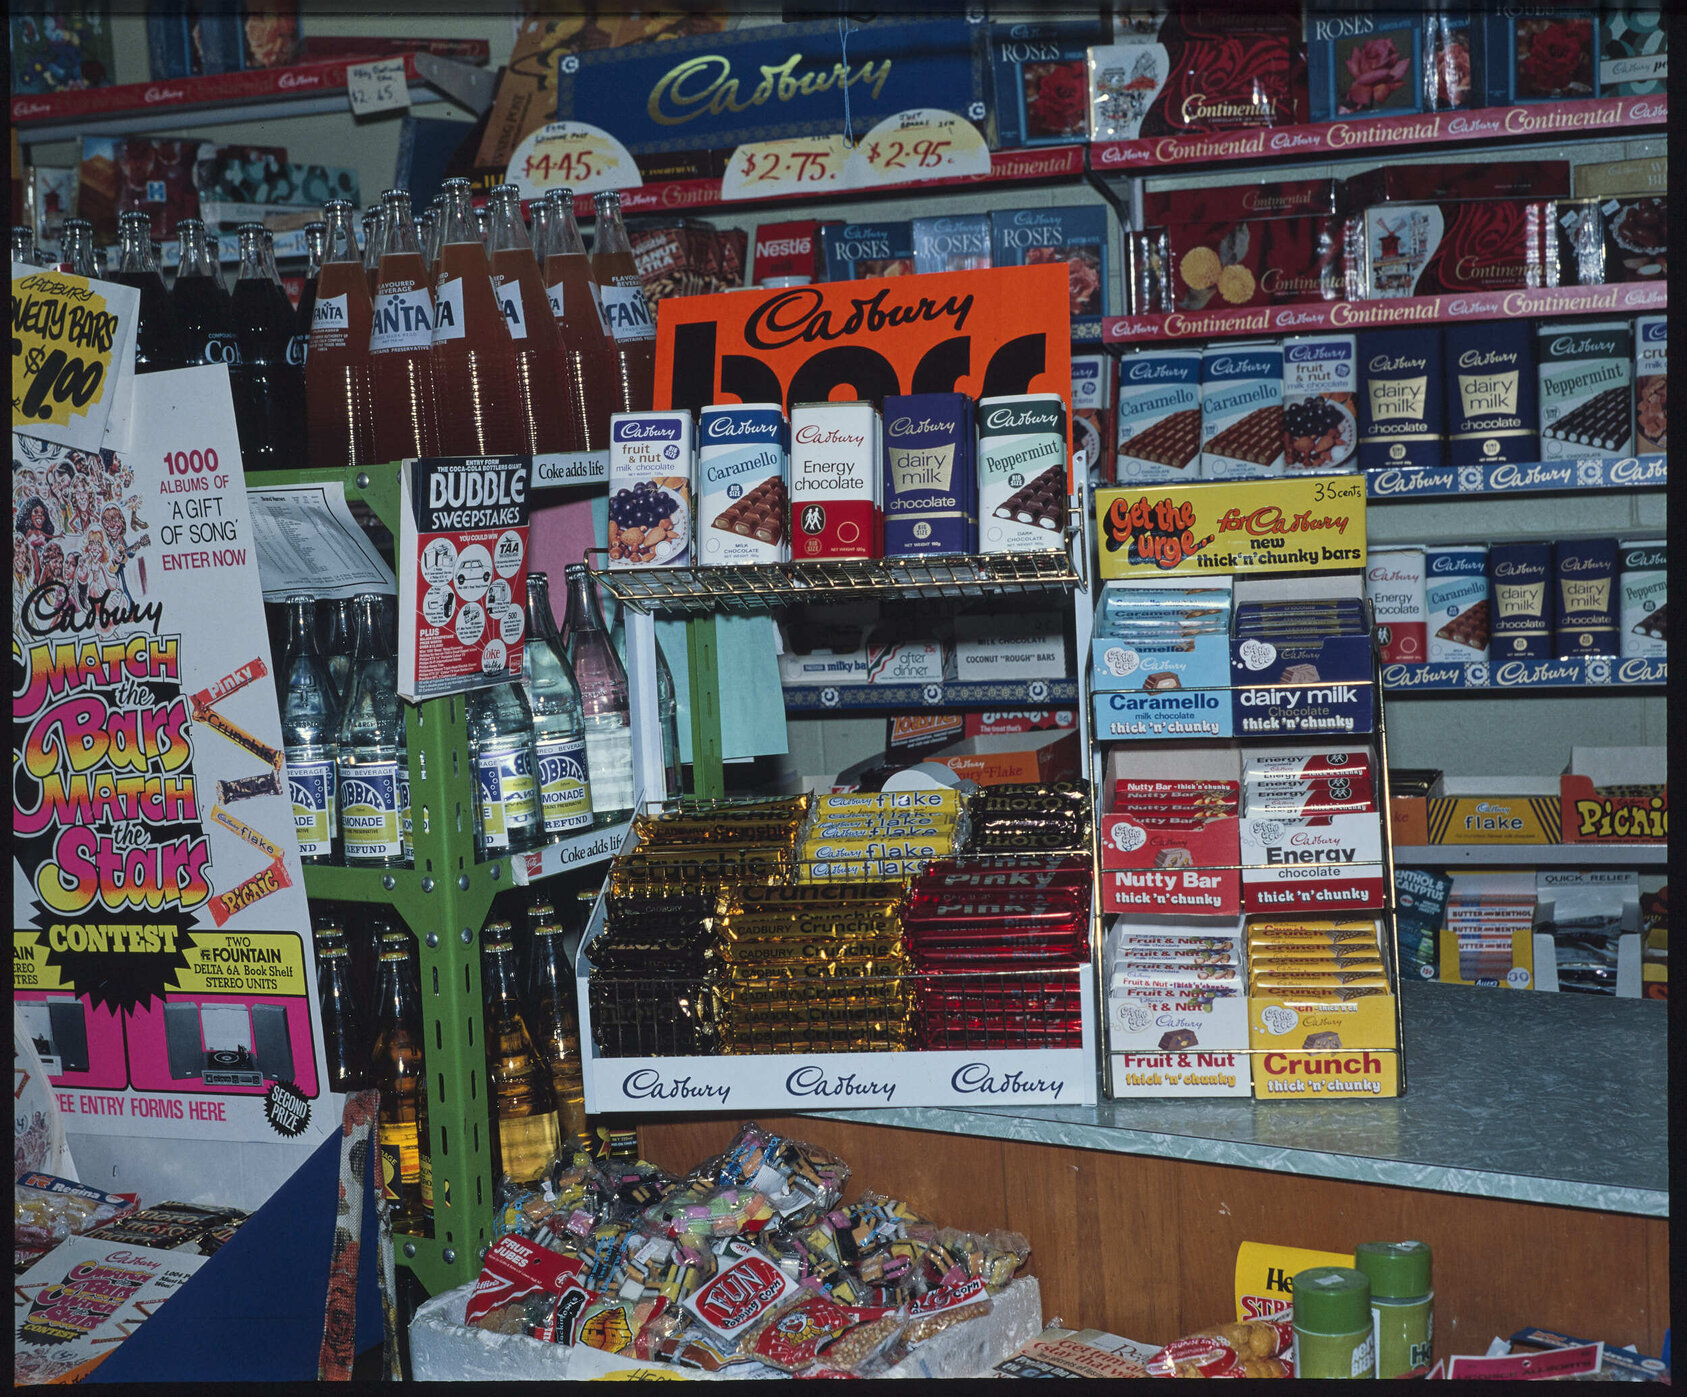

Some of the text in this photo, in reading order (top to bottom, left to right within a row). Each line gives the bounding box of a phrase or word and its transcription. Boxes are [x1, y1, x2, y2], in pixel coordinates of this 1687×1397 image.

[1316, 17, 1374, 41] ROSES
[1001, 43, 1060, 63] ROSES
[648, 53, 891, 125] Cadbury
[1101, 103, 1622, 164] Cadbury Continental Cadbury Continental Cadbury Continental
[924, 234, 983, 257] ROSES
[1004, 226, 1063, 249] ROSES
[835, 238, 890, 260] ROSES
[20, 275, 95, 303] CADBURY
[744, 288, 974, 350] Cadbury
[68, 307, 119, 353] BARS
[1551, 336, 1615, 355] Cadbury
[1296, 363, 1323, 374] fruit
[1459, 350, 1517, 368] Cadbury
[1309, 371, 1331, 381] nut
[1544, 363, 1624, 397] Peppermint
[1373, 383, 1421, 400] dairy
[1465, 378, 1513, 396] dairy
[1121, 390, 1194, 417] Caramello
[1203, 384, 1278, 413] Caramello
[1377, 398, 1416, 414] milk
[1470, 393, 1510, 410] milk
[708, 416, 778, 438] Cadbury
[889, 417, 955, 438] Cadbury
[987, 408, 1058, 429] Cadbury
[1368, 422, 1427, 434] chocolate
[1460, 417, 1521, 431] chocolate
[620, 422, 676, 439] Cadbury
[796, 424, 864, 447] Cadbury
[622, 444, 650, 455] fruit
[639, 453, 661, 463] nut
[986, 440, 1059, 473] Peppermint
[164, 448, 218, 475] 1000
[538, 460, 604, 480] Coke adds life
[616, 463, 675, 472] milk chocolate
[707, 451, 778, 482] Caramello
[803, 460, 855, 475] Energy
[897, 451, 946, 469] dairy
[160, 475, 229, 494] ALBUMS OF
[794, 475, 864, 491] chocolate
[902, 468, 942, 485] milk
[430, 469, 527, 509] BUBBLE
[186, 497, 222, 518] GIFT
[890, 496, 956, 510] chocolate
[432, 507, 520, 529] SWEEPSTAKES
[1104, 496, 1196, 551] Get the
[1217, 506, 1349, 535] for Cadbury
[161, 525, 183, 545] OF
[1251, 536, 1285, 549] new
[500, 543, 519, 554] TAA
[1130, 528, 1214, 571] urge
[162, 549, 246, 570] ENTER NOW
[1374, 592, 1413, 606] Energy
[1432, 581, 1485, 605] Caramello
[1500, 587, 1539, 602] dairy
[21, 580, 162, 636] Cadbury
[1505, 599, 1534, 611] milk
[420, 628, 440, 637] PLUS
[900, 652, 926, 664] after
[966, 653, 1056, 664] COCONUT "ROUGH" BARS
[13, 635, 181, 717] MATCH
[893, 663, 929, 677] dinner
[1383, 660, 1579, 689] Cadbury Cadbury
[116, 682, 154, 706] the
[1109, 692, 1219, 711] Caramello
[1240, 686, 1358, 709] dairy milk
[1135, 711, 1195, 720] milk chocolate
[1268, 706, 1330, 718] Chocolate
[26, 695, 194, 778] Bars
[1110, 720, 1147, 735] thick
[1167, 720, 1220, 735] chunky
[13, 770, 201, 835] MATCH
[828, 791, 943, 808] Cadbury flake
[546, 816, 589, 829] REFUND
[1465, 814, 1524, 831] flake
[113, 823, 149, 847] the
[560, 846, 586, 865] Coke
[587, 840, 608, 857] adds
[815, 843, 935, 859] Cadbury flake
[1267, 846, 1356, 864] Energy
[37, 826, 213, 913] Stars
[1278, 866, 1341, 878] chocolate
[1545, 873, 1632, 883] QUICK RELIEF
[1115, 871, 1222, 891] Nutty Bar
[1115, 892, 1150, 904] thick
[1171, 893, 1222, 907] chunky
[49, 924, 178, 953] CONTEST
[225, 937, 251, 947] TWO
[213, 948, 281, 963] FOUNTAIN
[194, 964, 293, 977] DELTA 6A Book Shelf
[206, 977, 278, 990] STEREO UNITS
[1124, 1053, 1235, 1068] Fruit & Nut
[1264, 1052, 1381, 1075] Crunch
[622, 1062, 1064, 1104] Cadbury Cadbury Cadbury
[81, 1097, 124, 1116] ENTRY
[131, 1098, 184, 1119] FORMS
[189, 1102, 227, 1121] HERE
[270, 1085, 308, 1117] SECOND
[270, 1103, 299, 1133] PRIZE
[52, 1182, 100, 1200] Regina
[494, 1246, 529, 1269] JUBES
[499, 1237, 533, 1258] FRUIT
[703, 1262, 768, 1317] FUN
[953, 1280, 980, 1298] Corn
[722, 1279, 782, 1328] Popping Corn
[24, 1323, 79, 1340] CONTEST
[1059, 1340, 1125, 1367] Get trim
